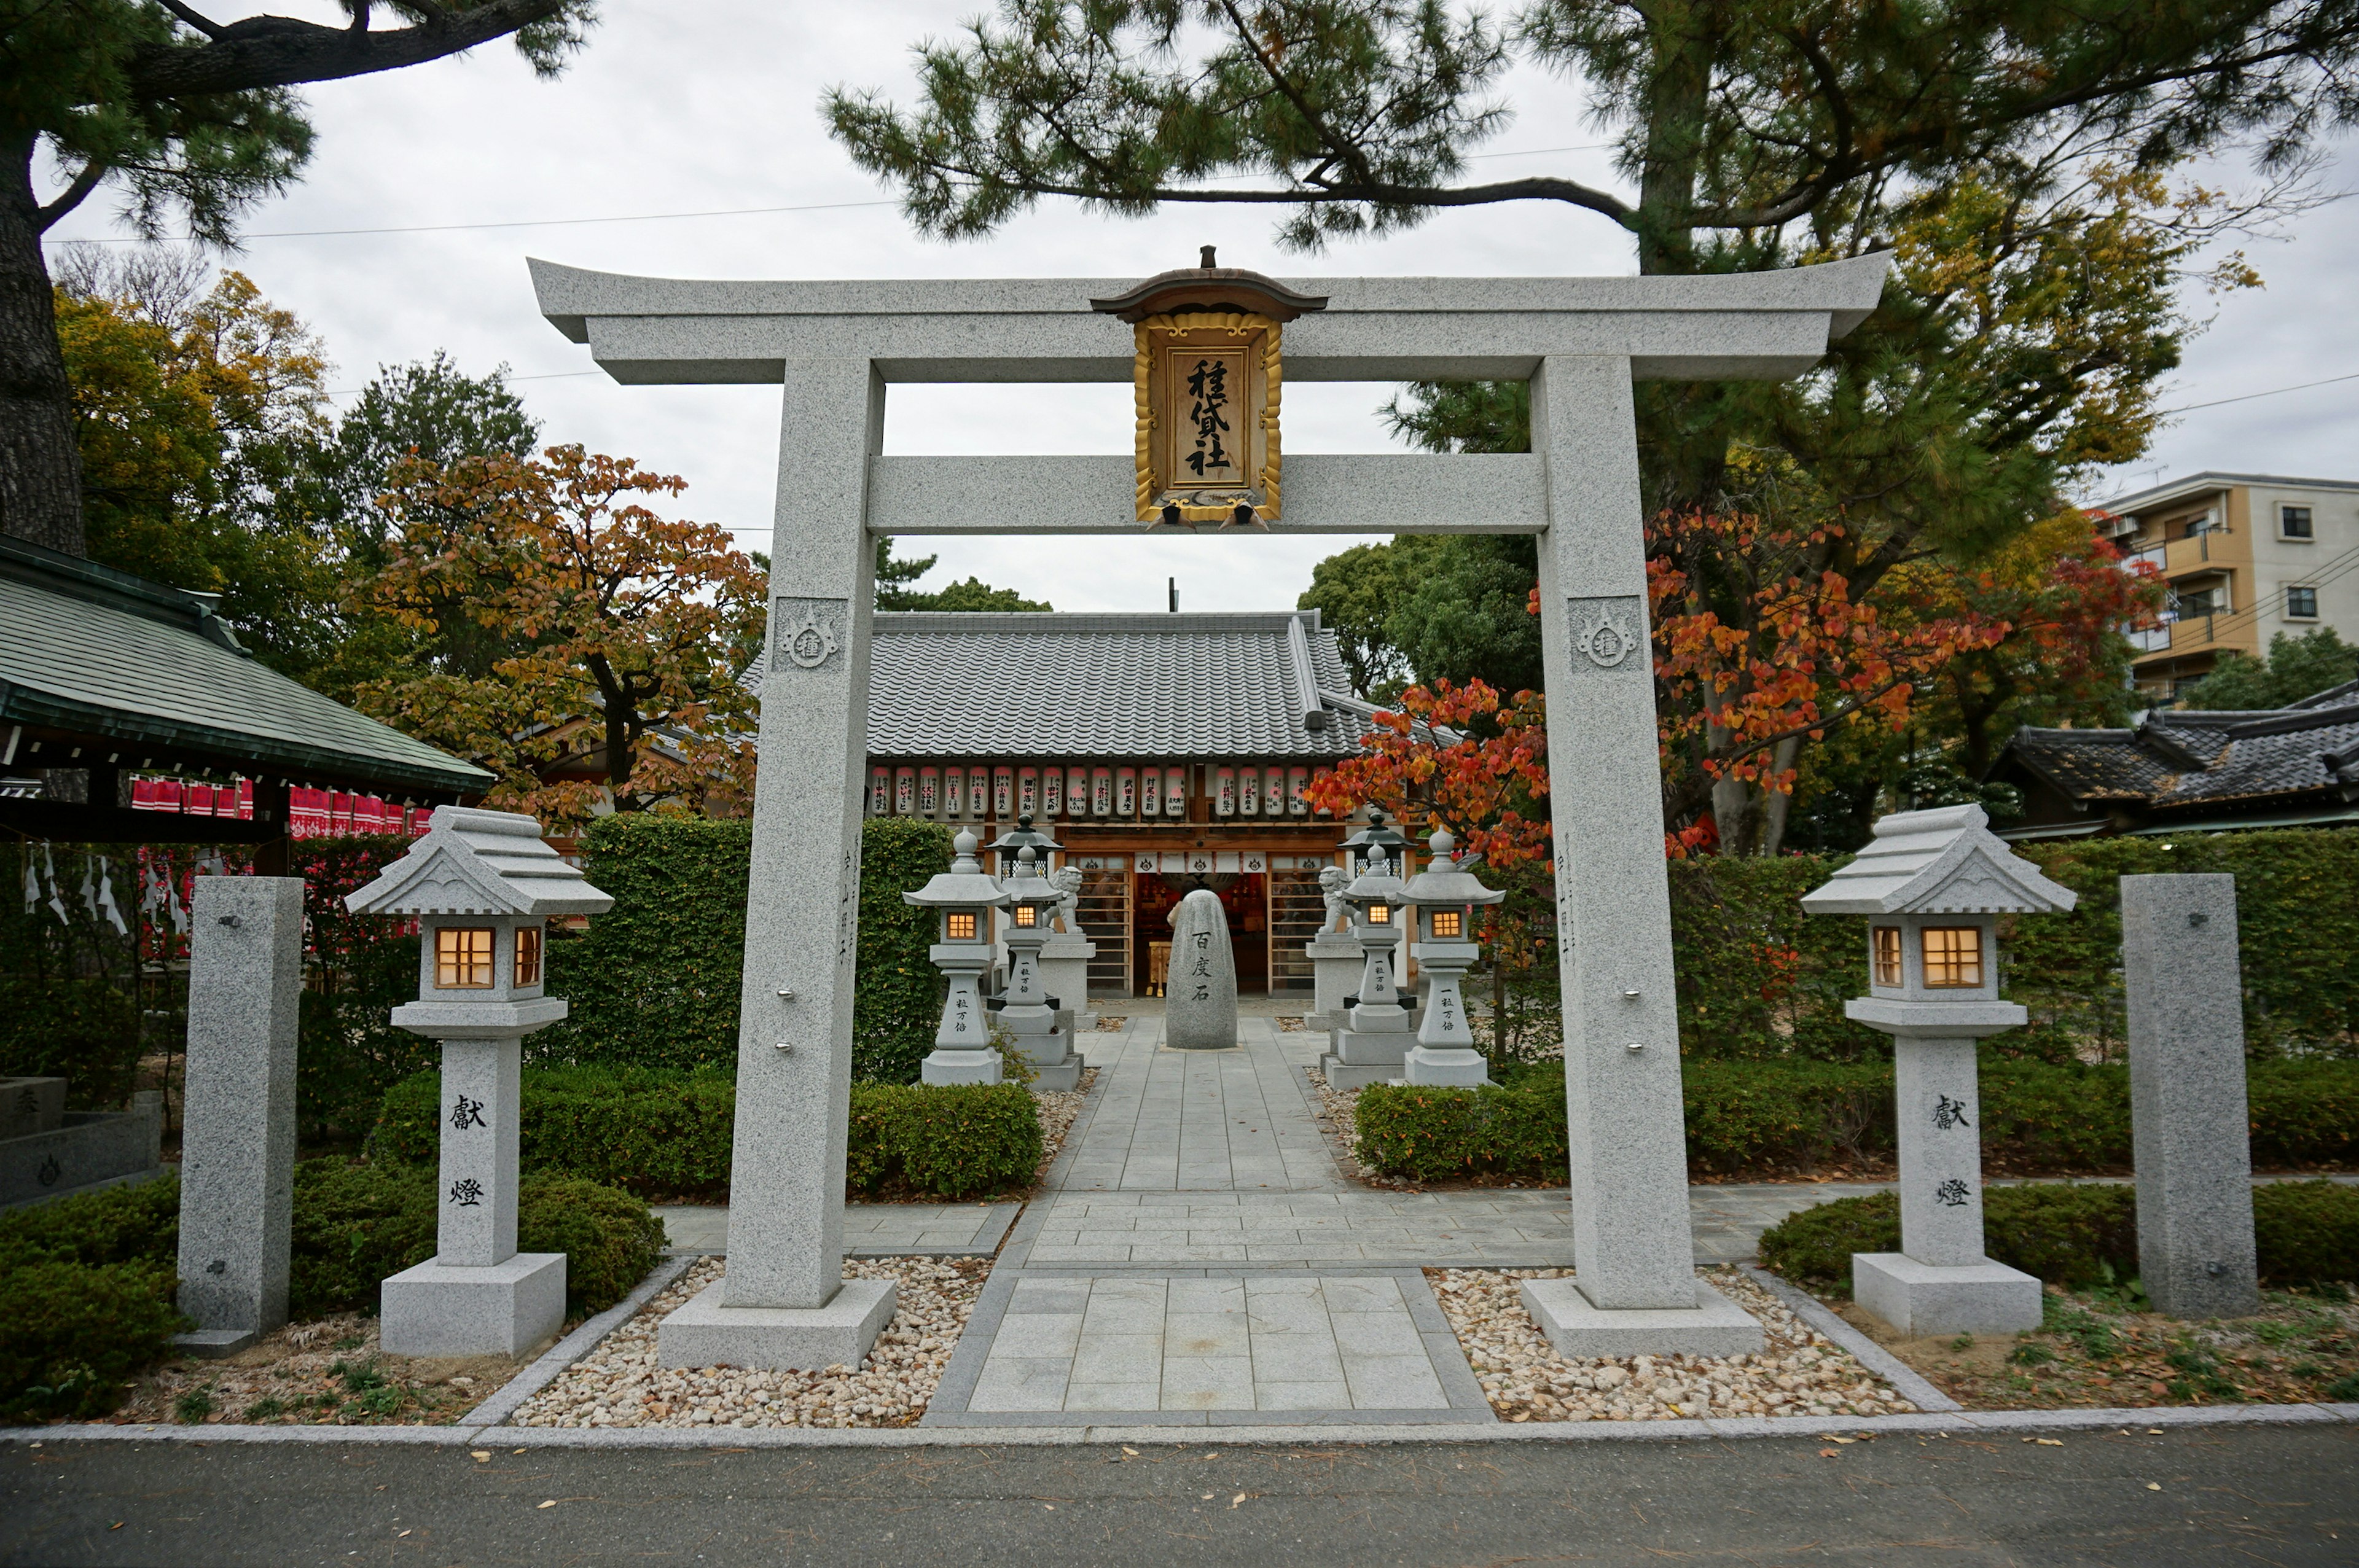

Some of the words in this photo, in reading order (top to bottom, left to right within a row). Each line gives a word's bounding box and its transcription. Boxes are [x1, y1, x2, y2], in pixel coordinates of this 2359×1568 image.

[1185, 360, 1230, 476] 種貸社
[1019, 962, 1030, 993] 一粒万倍
[1192, 932, 1211, 1001] 百度石
[1375, 961, 1385, 991] 一粒万倍
[954, 990, 968, 1032] 一粒万倍
[1441, 989, 1454, 1031] 一粒万倍
